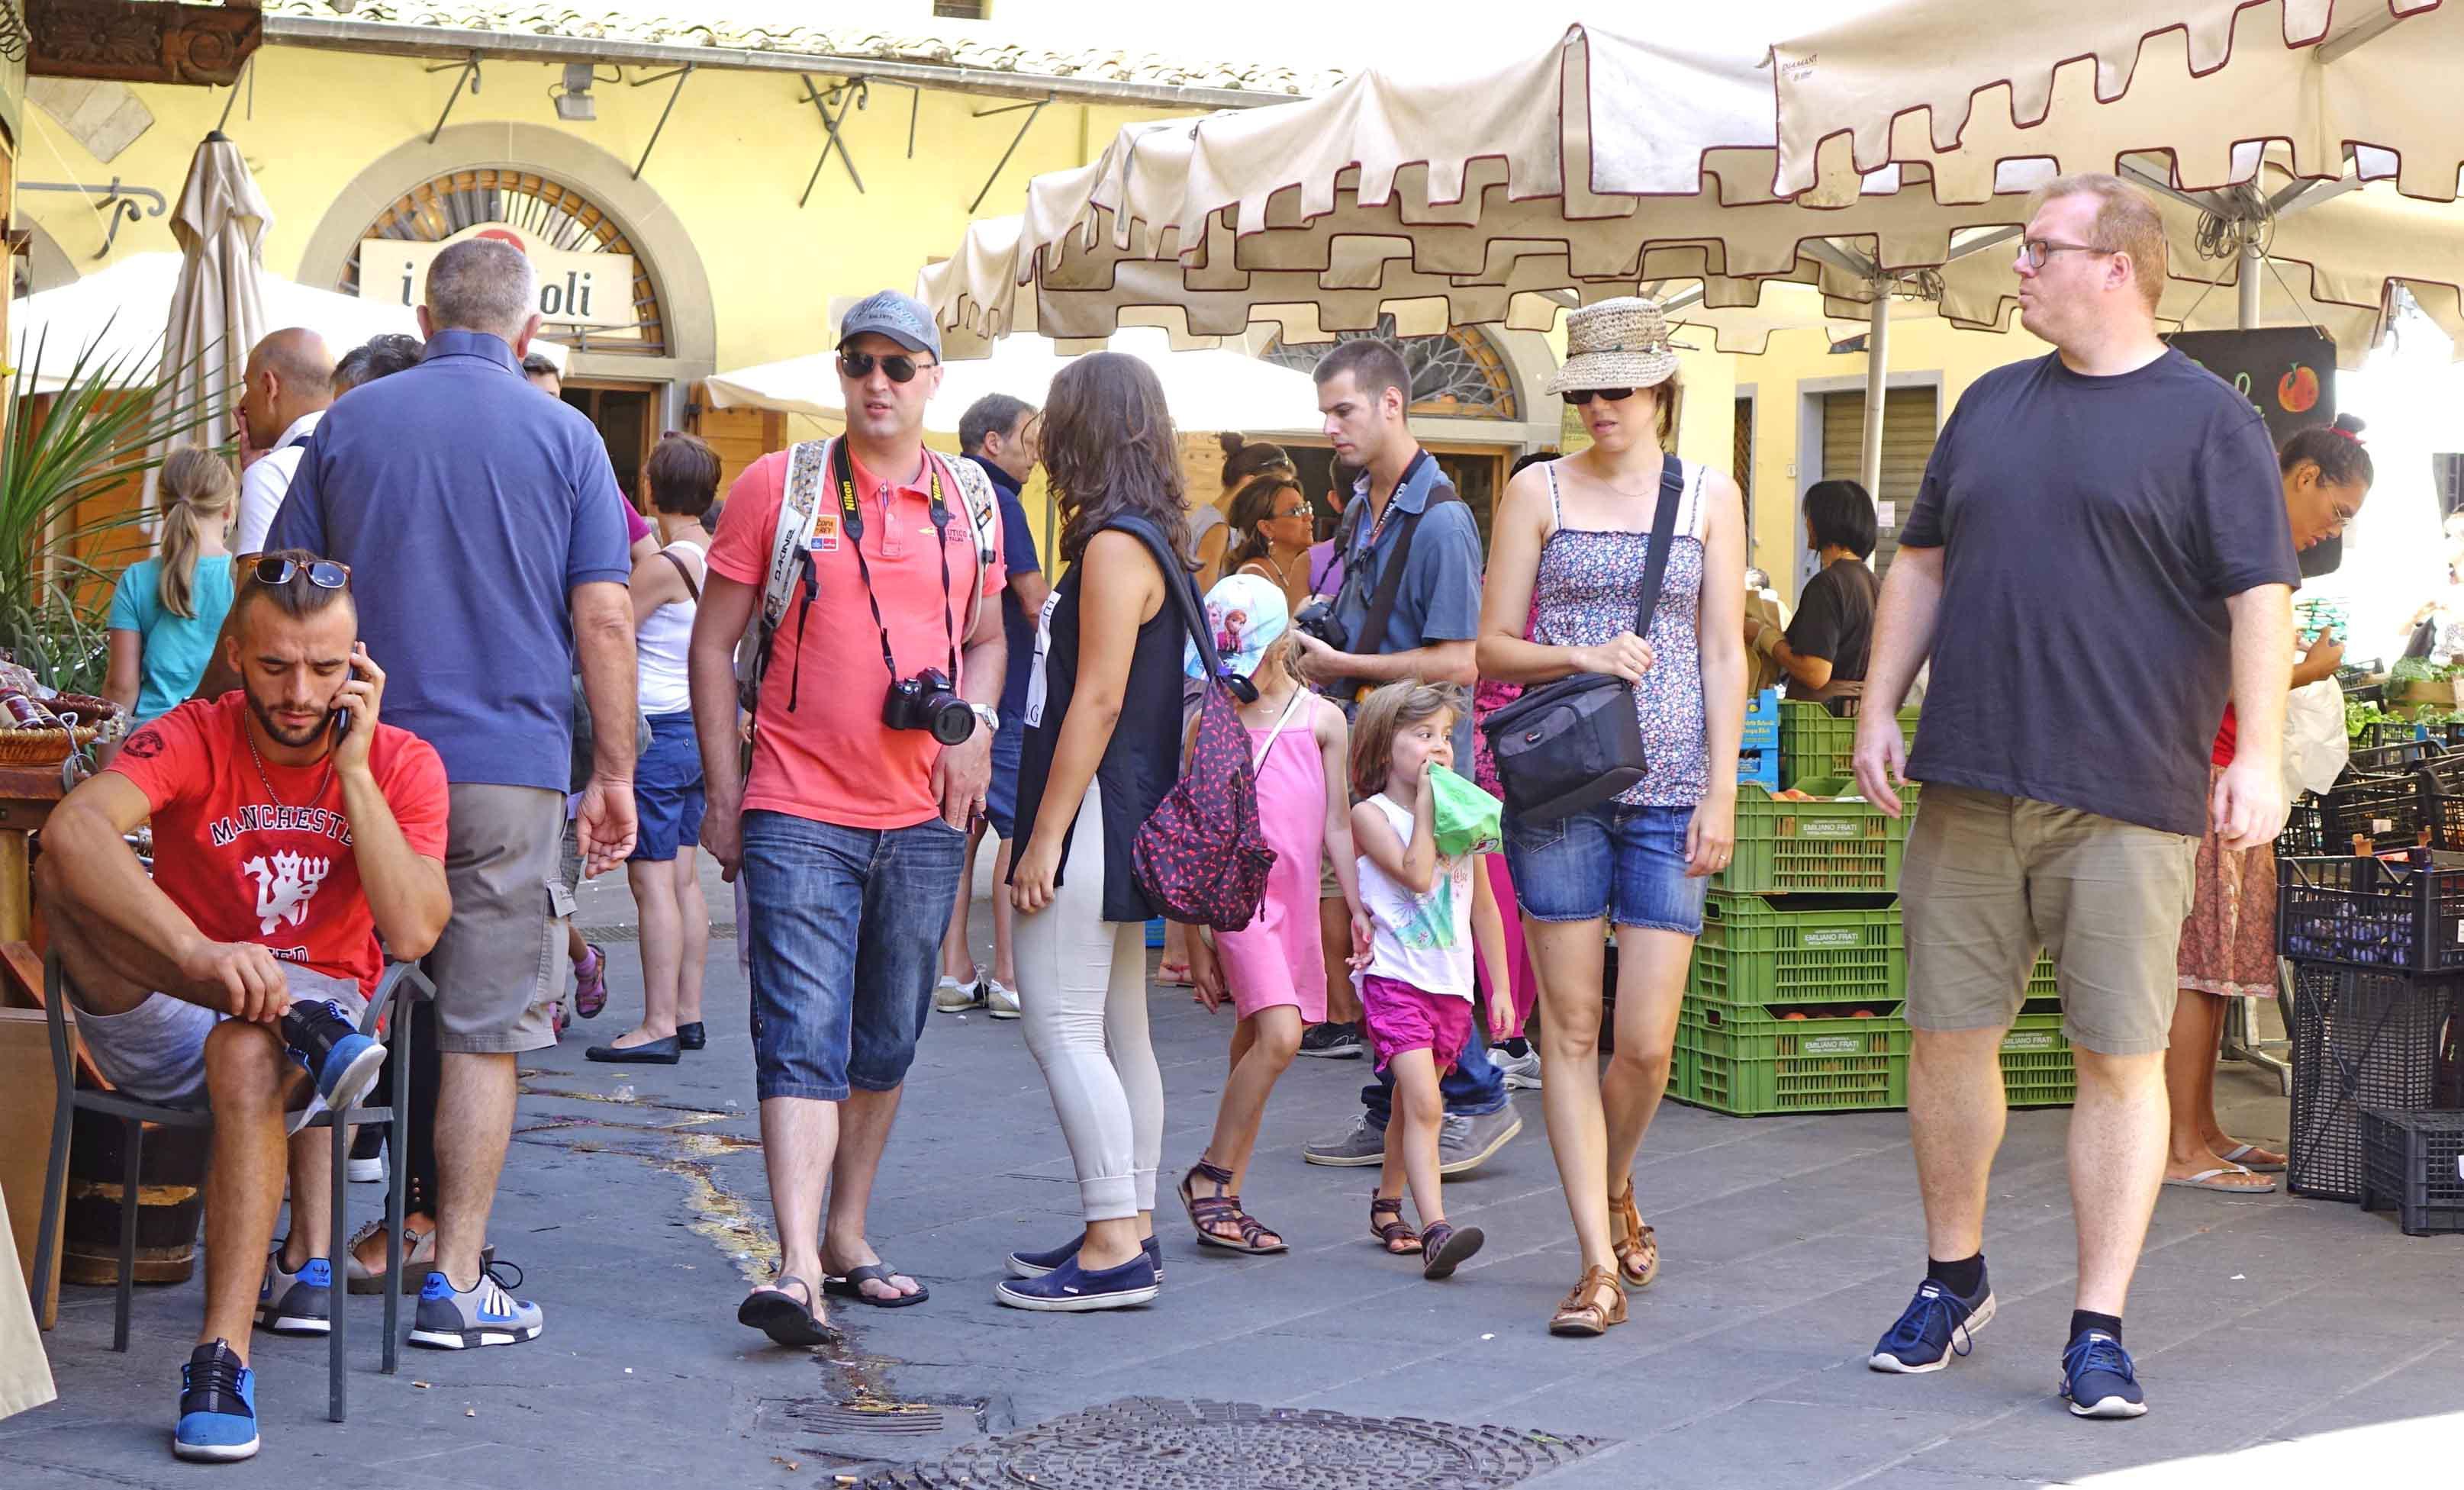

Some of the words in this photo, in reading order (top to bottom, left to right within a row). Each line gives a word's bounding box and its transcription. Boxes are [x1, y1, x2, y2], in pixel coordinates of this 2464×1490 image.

[401, 261, 414, 307] i
[842, 481, 856, 511] Nikon
[946, 528, 968, 539] UTICO
